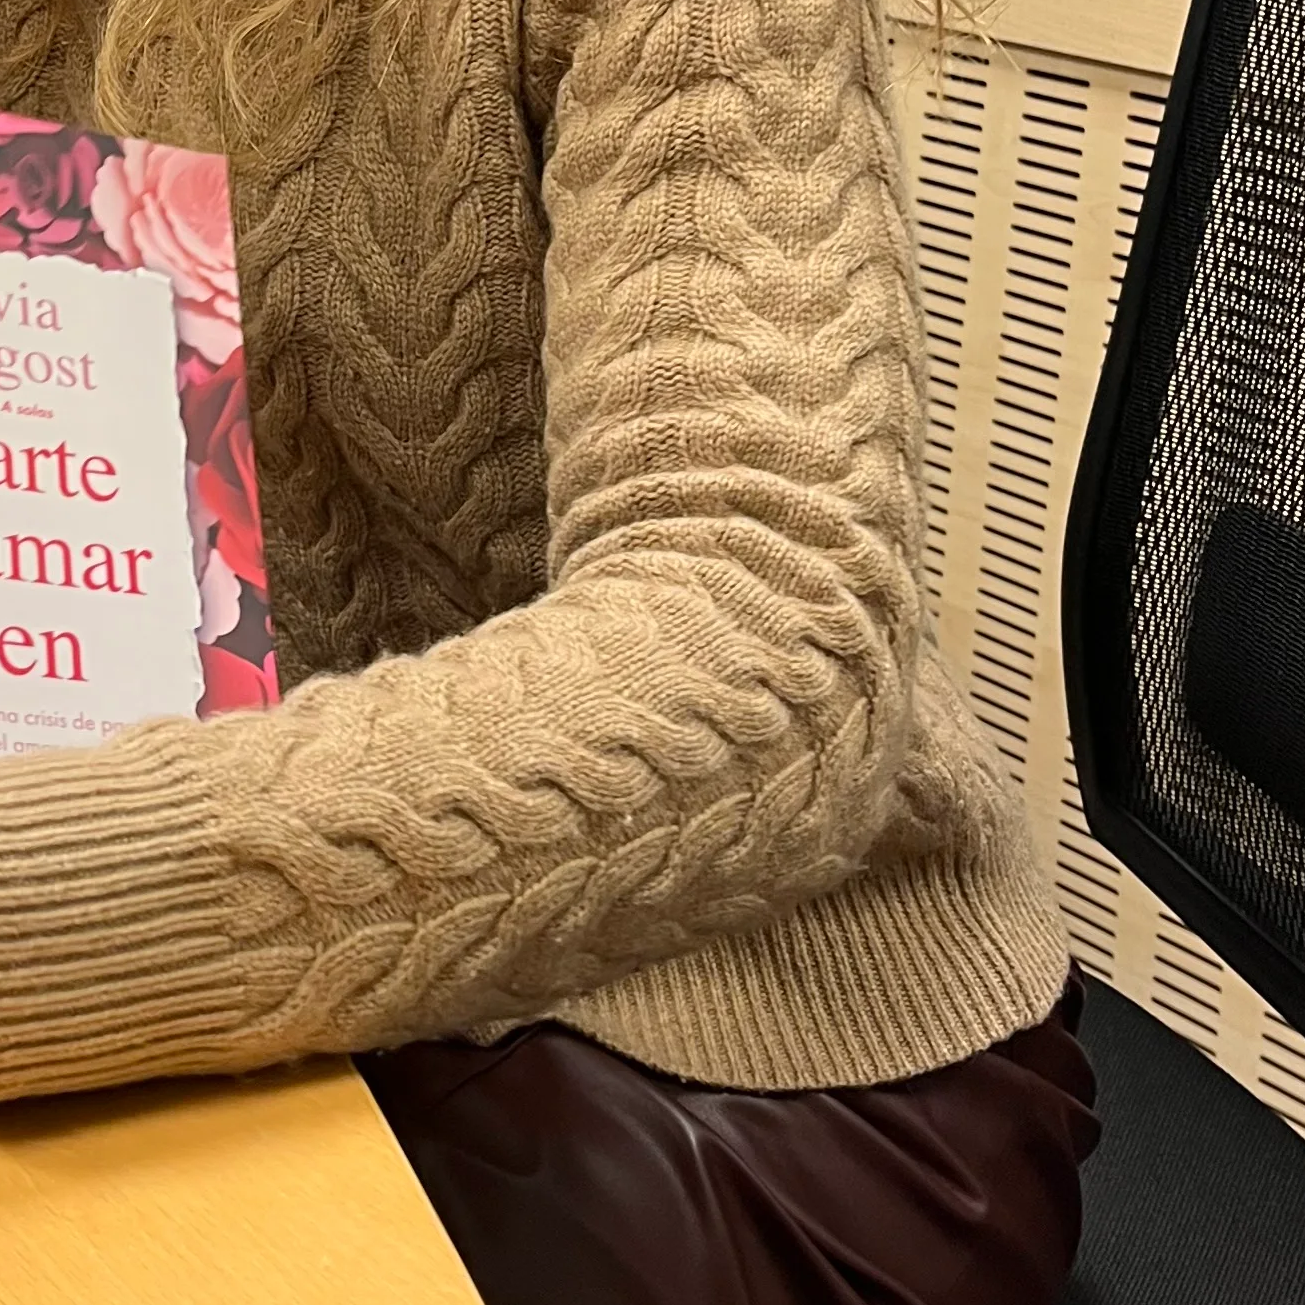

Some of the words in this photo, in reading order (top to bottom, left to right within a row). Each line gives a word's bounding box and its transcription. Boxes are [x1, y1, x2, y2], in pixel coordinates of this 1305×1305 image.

[0, 400, 13, 414] A
[16, 403, 55, 419] solas
[24, 710, 67, 729] crisis
[72, 712, 96, 731] de
